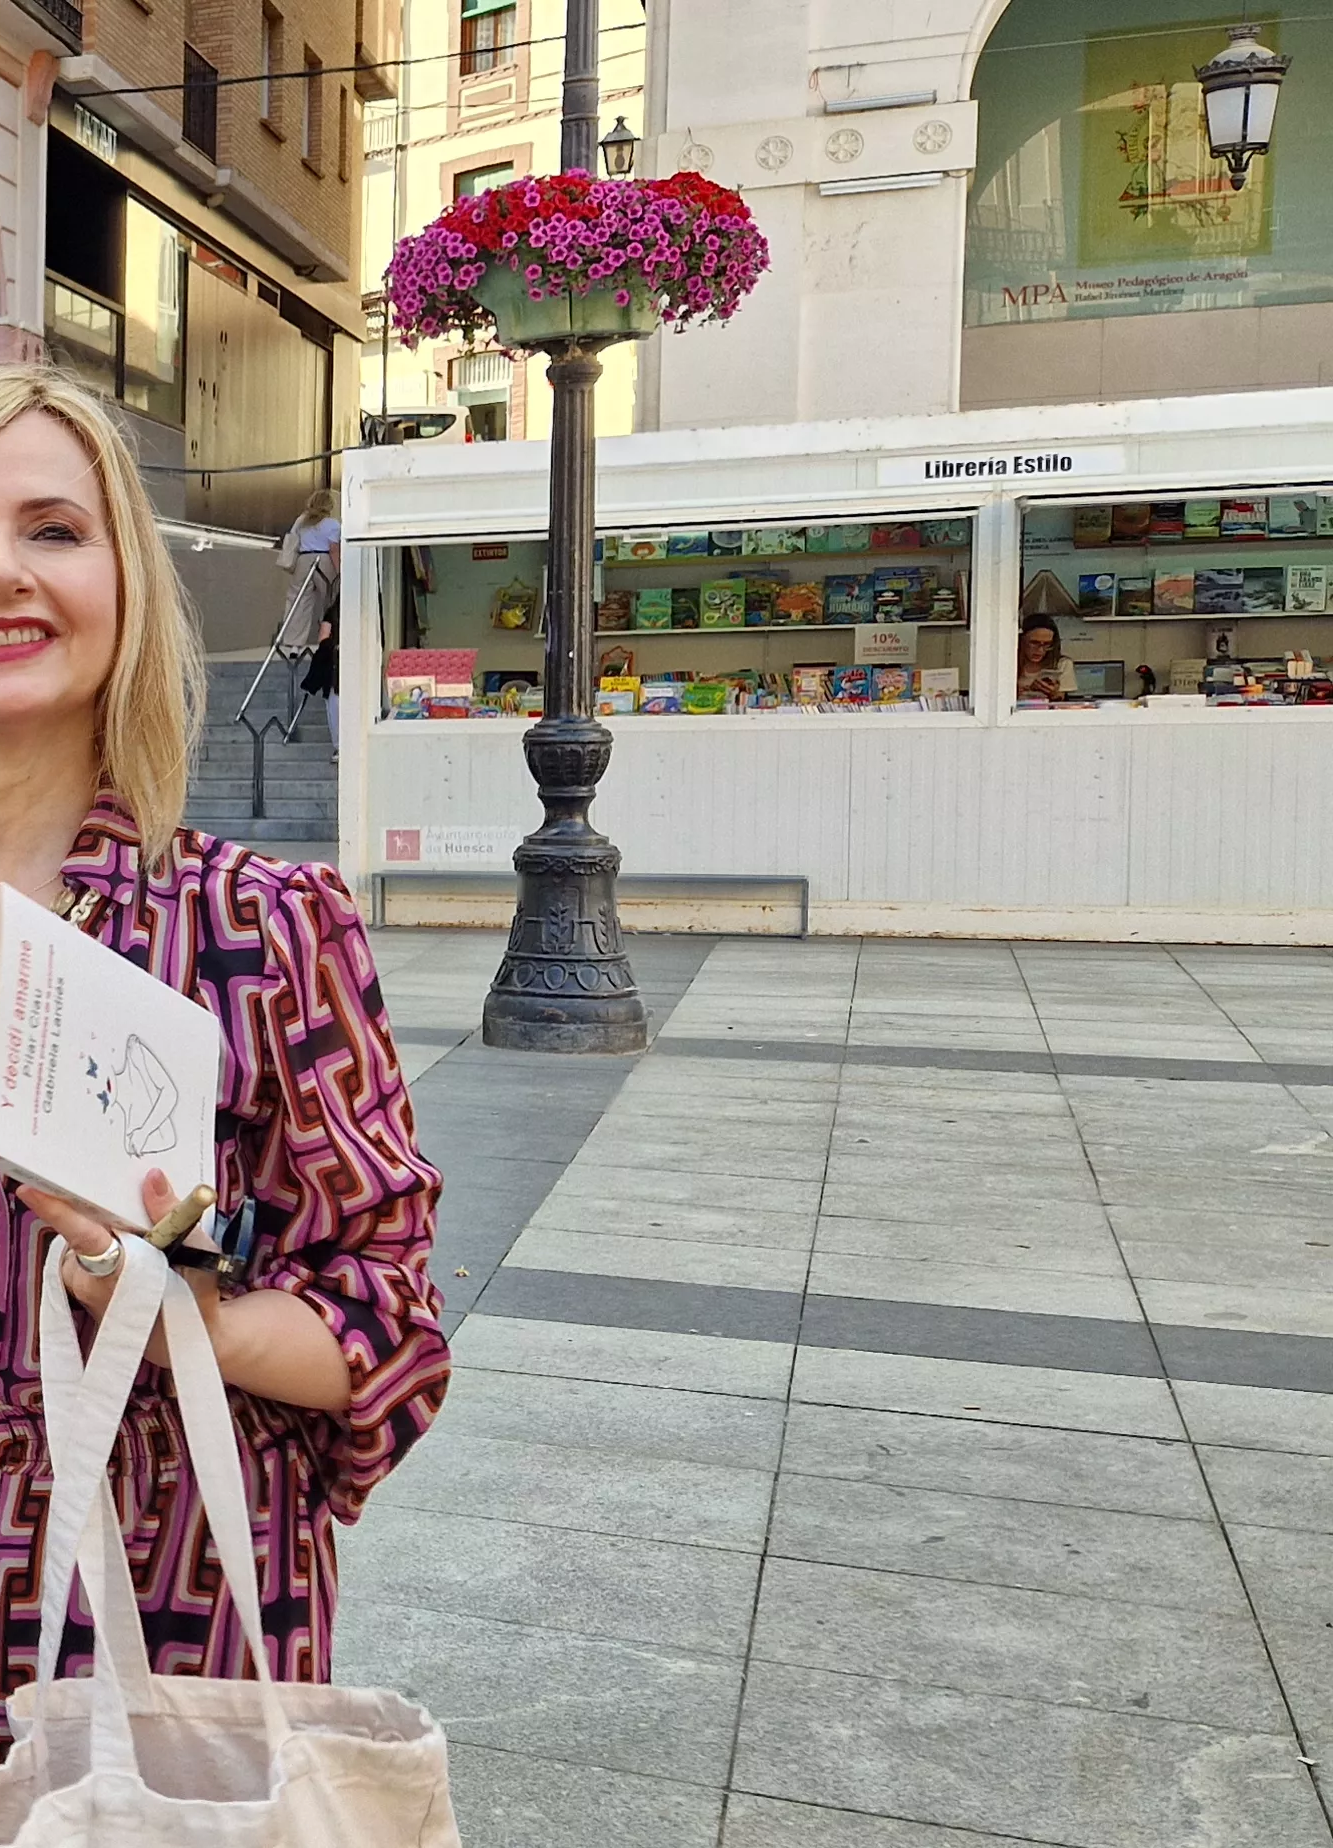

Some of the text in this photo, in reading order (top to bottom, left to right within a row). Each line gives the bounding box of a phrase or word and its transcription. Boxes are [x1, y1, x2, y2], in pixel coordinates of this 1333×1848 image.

[74, 102, 117, 165] TATAU
[1075, 270, 1248, 291] Museo Pedagógico de Aragón
[1002, 283, 1068, 308] MPA
[924, 453, 1073, 480] Librería Estilo
[872, 633, 900, 644] 10%
[445, 843, 493, 854] Huesca
[1, 1094, 14, 1108] Y
[14, 939, 32, 1021] amarme
[22, 988, 42, 1078] Pilar Clau
[43, 1043, 59, 1114] Gabriela
